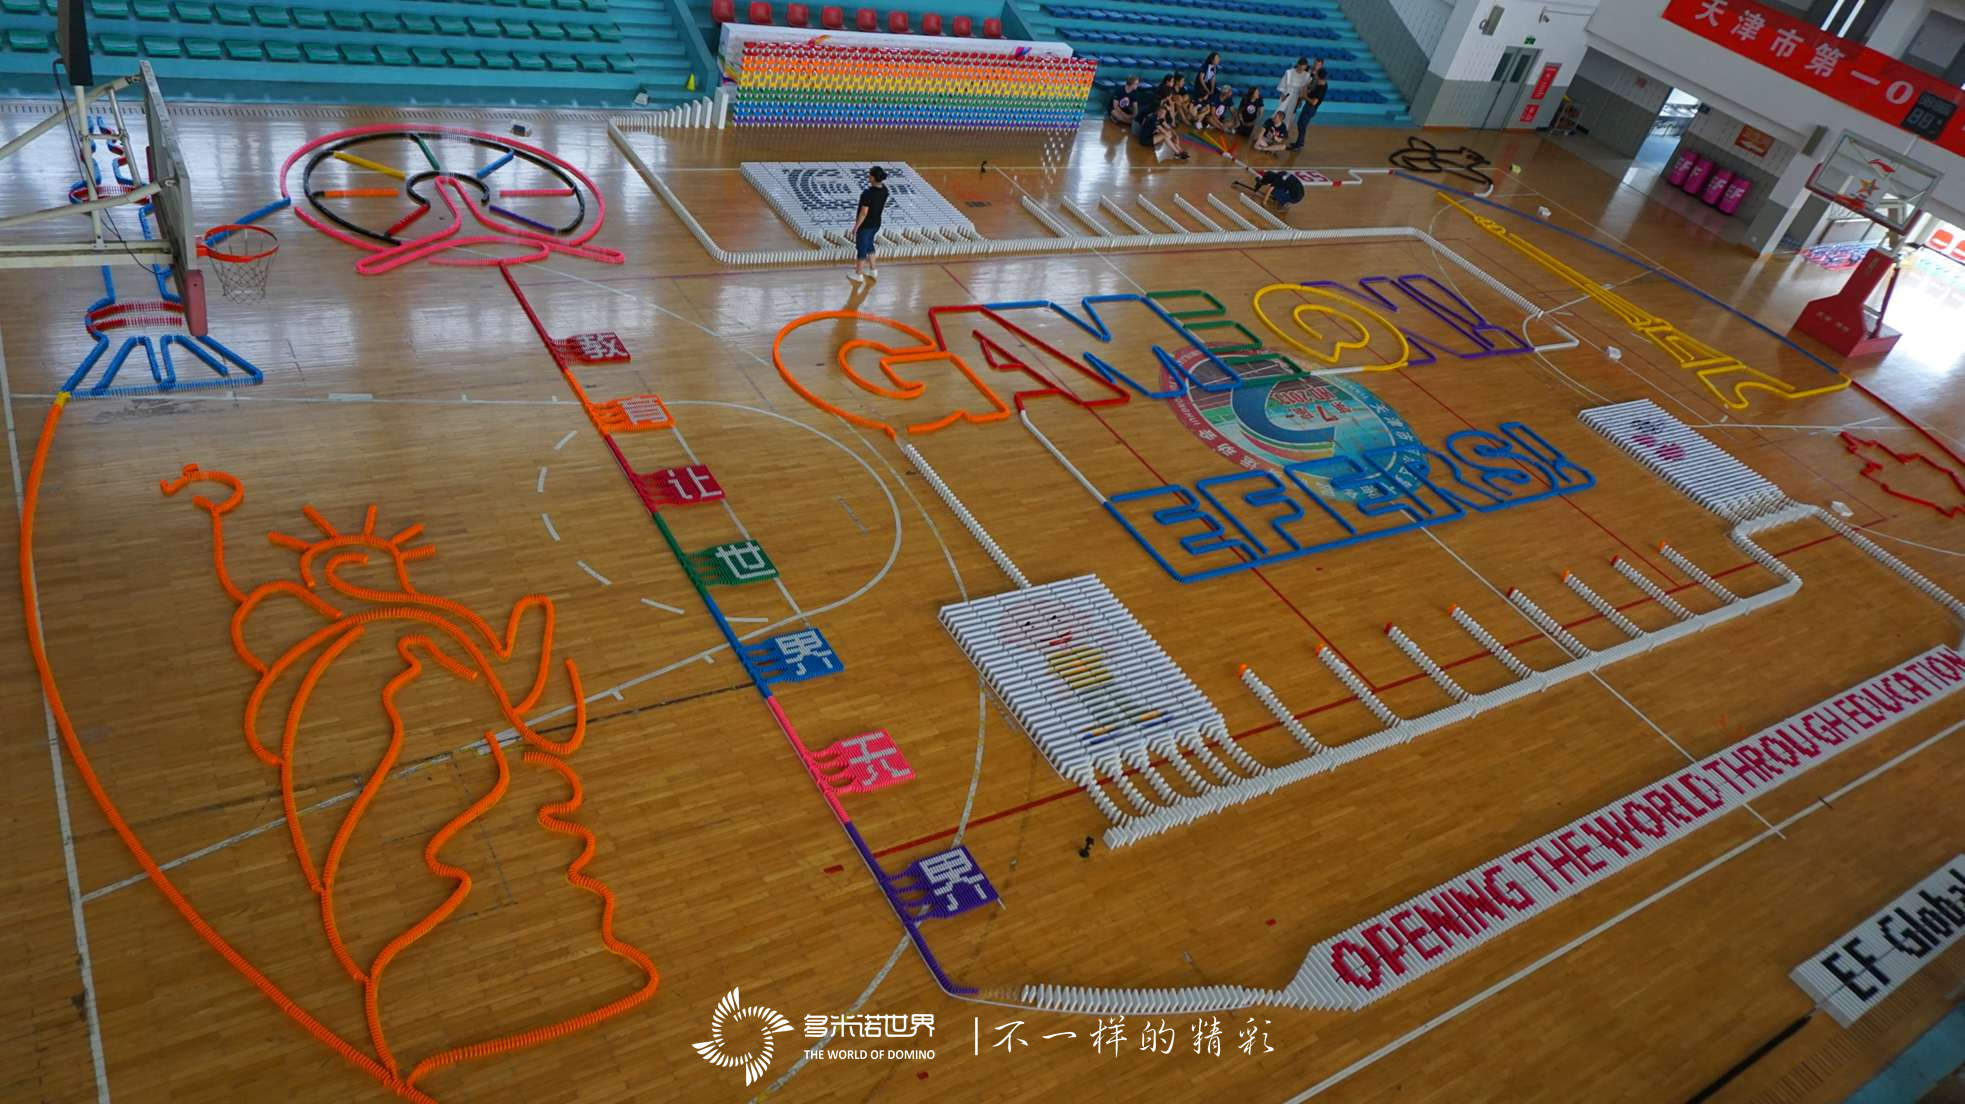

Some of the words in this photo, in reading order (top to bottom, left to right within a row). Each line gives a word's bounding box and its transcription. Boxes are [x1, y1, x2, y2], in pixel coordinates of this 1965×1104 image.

[1725, 183, 1745, 200] EF
[667, 466, 723, 500] 让
[715, 540, 777, 579] 世
[774, 629, 834, 675] 界
[841, 731, 911, 786] 无
[918, 848, 988, 912] 界
[1331, 866, 1537, 992] OPENING
[1513, 830, 1608, 893] THE
[1596, 773, 1725, 858] WORLD
[1702, 706, 1850, 795] THROUGH
[1832, 647, 1965, 734] EDUCATION
[1821, 936, 1891, 1002] EF
